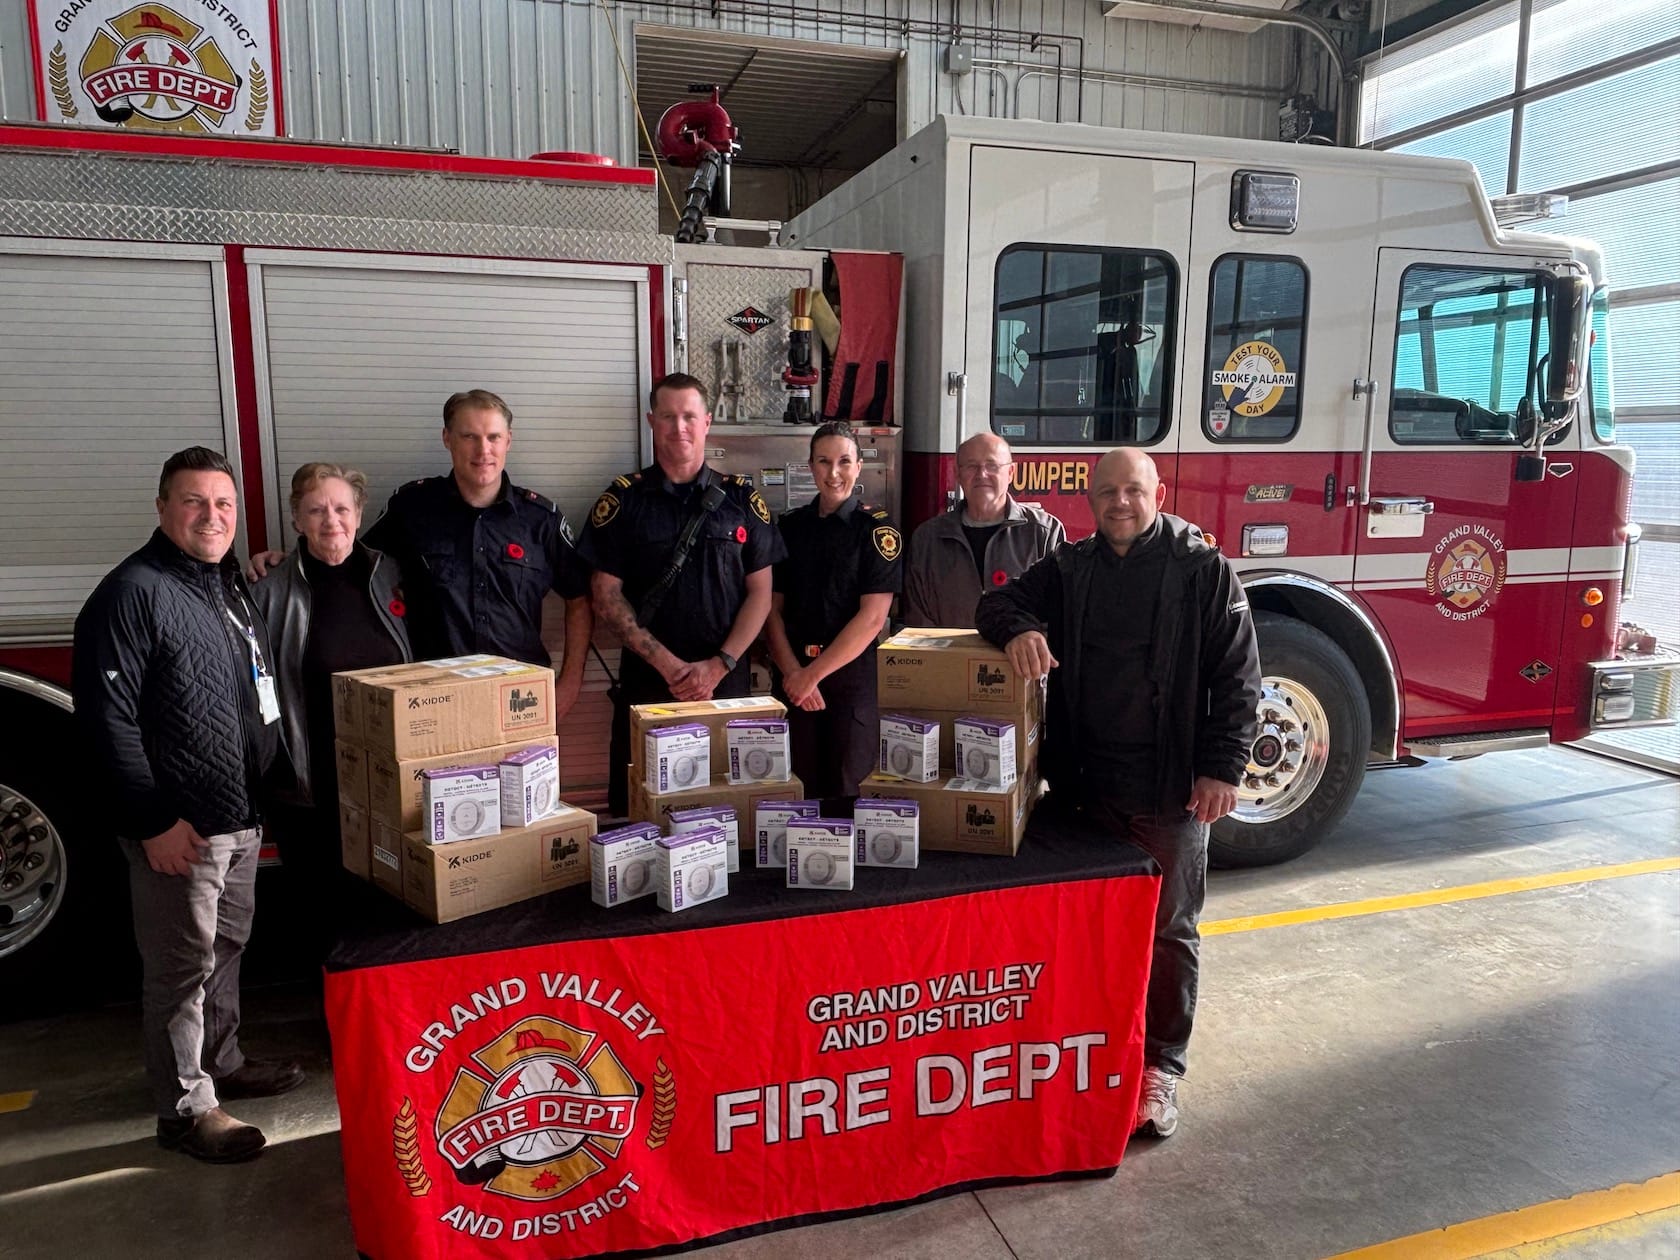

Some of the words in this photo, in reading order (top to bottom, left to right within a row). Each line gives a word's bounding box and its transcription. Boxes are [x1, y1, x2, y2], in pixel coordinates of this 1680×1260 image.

[54, 0, 92, 33] GRA
[201, 0, 258, 50] STRICT
[91, 70, 150, 99] FIRE
[158, 72, 227, 107] DEPT.
[731, 316, 770, 324] SPARTAN
[1231, 345, 1252, 365] TEST
[1257, 345, 1280, 366] YOUR
[1214, 373, 1250, 383] SMOKE
[1259, 374, 1294, 384] ALARM
[1246, 404, 1264, 414] DAY
[1013, 461, 1089, 491] UMPER
[1435, 524, 1470, 554] GRAND
[1473, 524, 1505, 553] VALLEY
[1442, 573, 1464, 588] FIRE
[1466, 572, 1491, 586] DEPT.
[1435, 602, 1452, 618] AND
[1453, 600, 1491, 621] DISTRICT
[422, 695, 451, 706] KIDDE
[511, 713, 521, 721] UN
[462, 850, 492, 864] KIDDE
[808, 981, 920, 1023] GRAND
[928, 962, 1044, 1002] VALLEY
[405, 977, 527, 1073] GRAND
[538, 972, 665, 1041] VALLEY
[819, 1016, 888, 1053] AND
[897, 995, 1030, 1041] DISTRICT
[714, 1067, 891, 1153] FIRE
[916, 1033, 1122, 1117] DEPT.
[449, 1104, 529, 1157] FIRE
[538, 1100, 625, 1130] DEPT.
[440, 1203, 504, 1240] AND
[512, 1172, 642, 1241] DISTRICT
